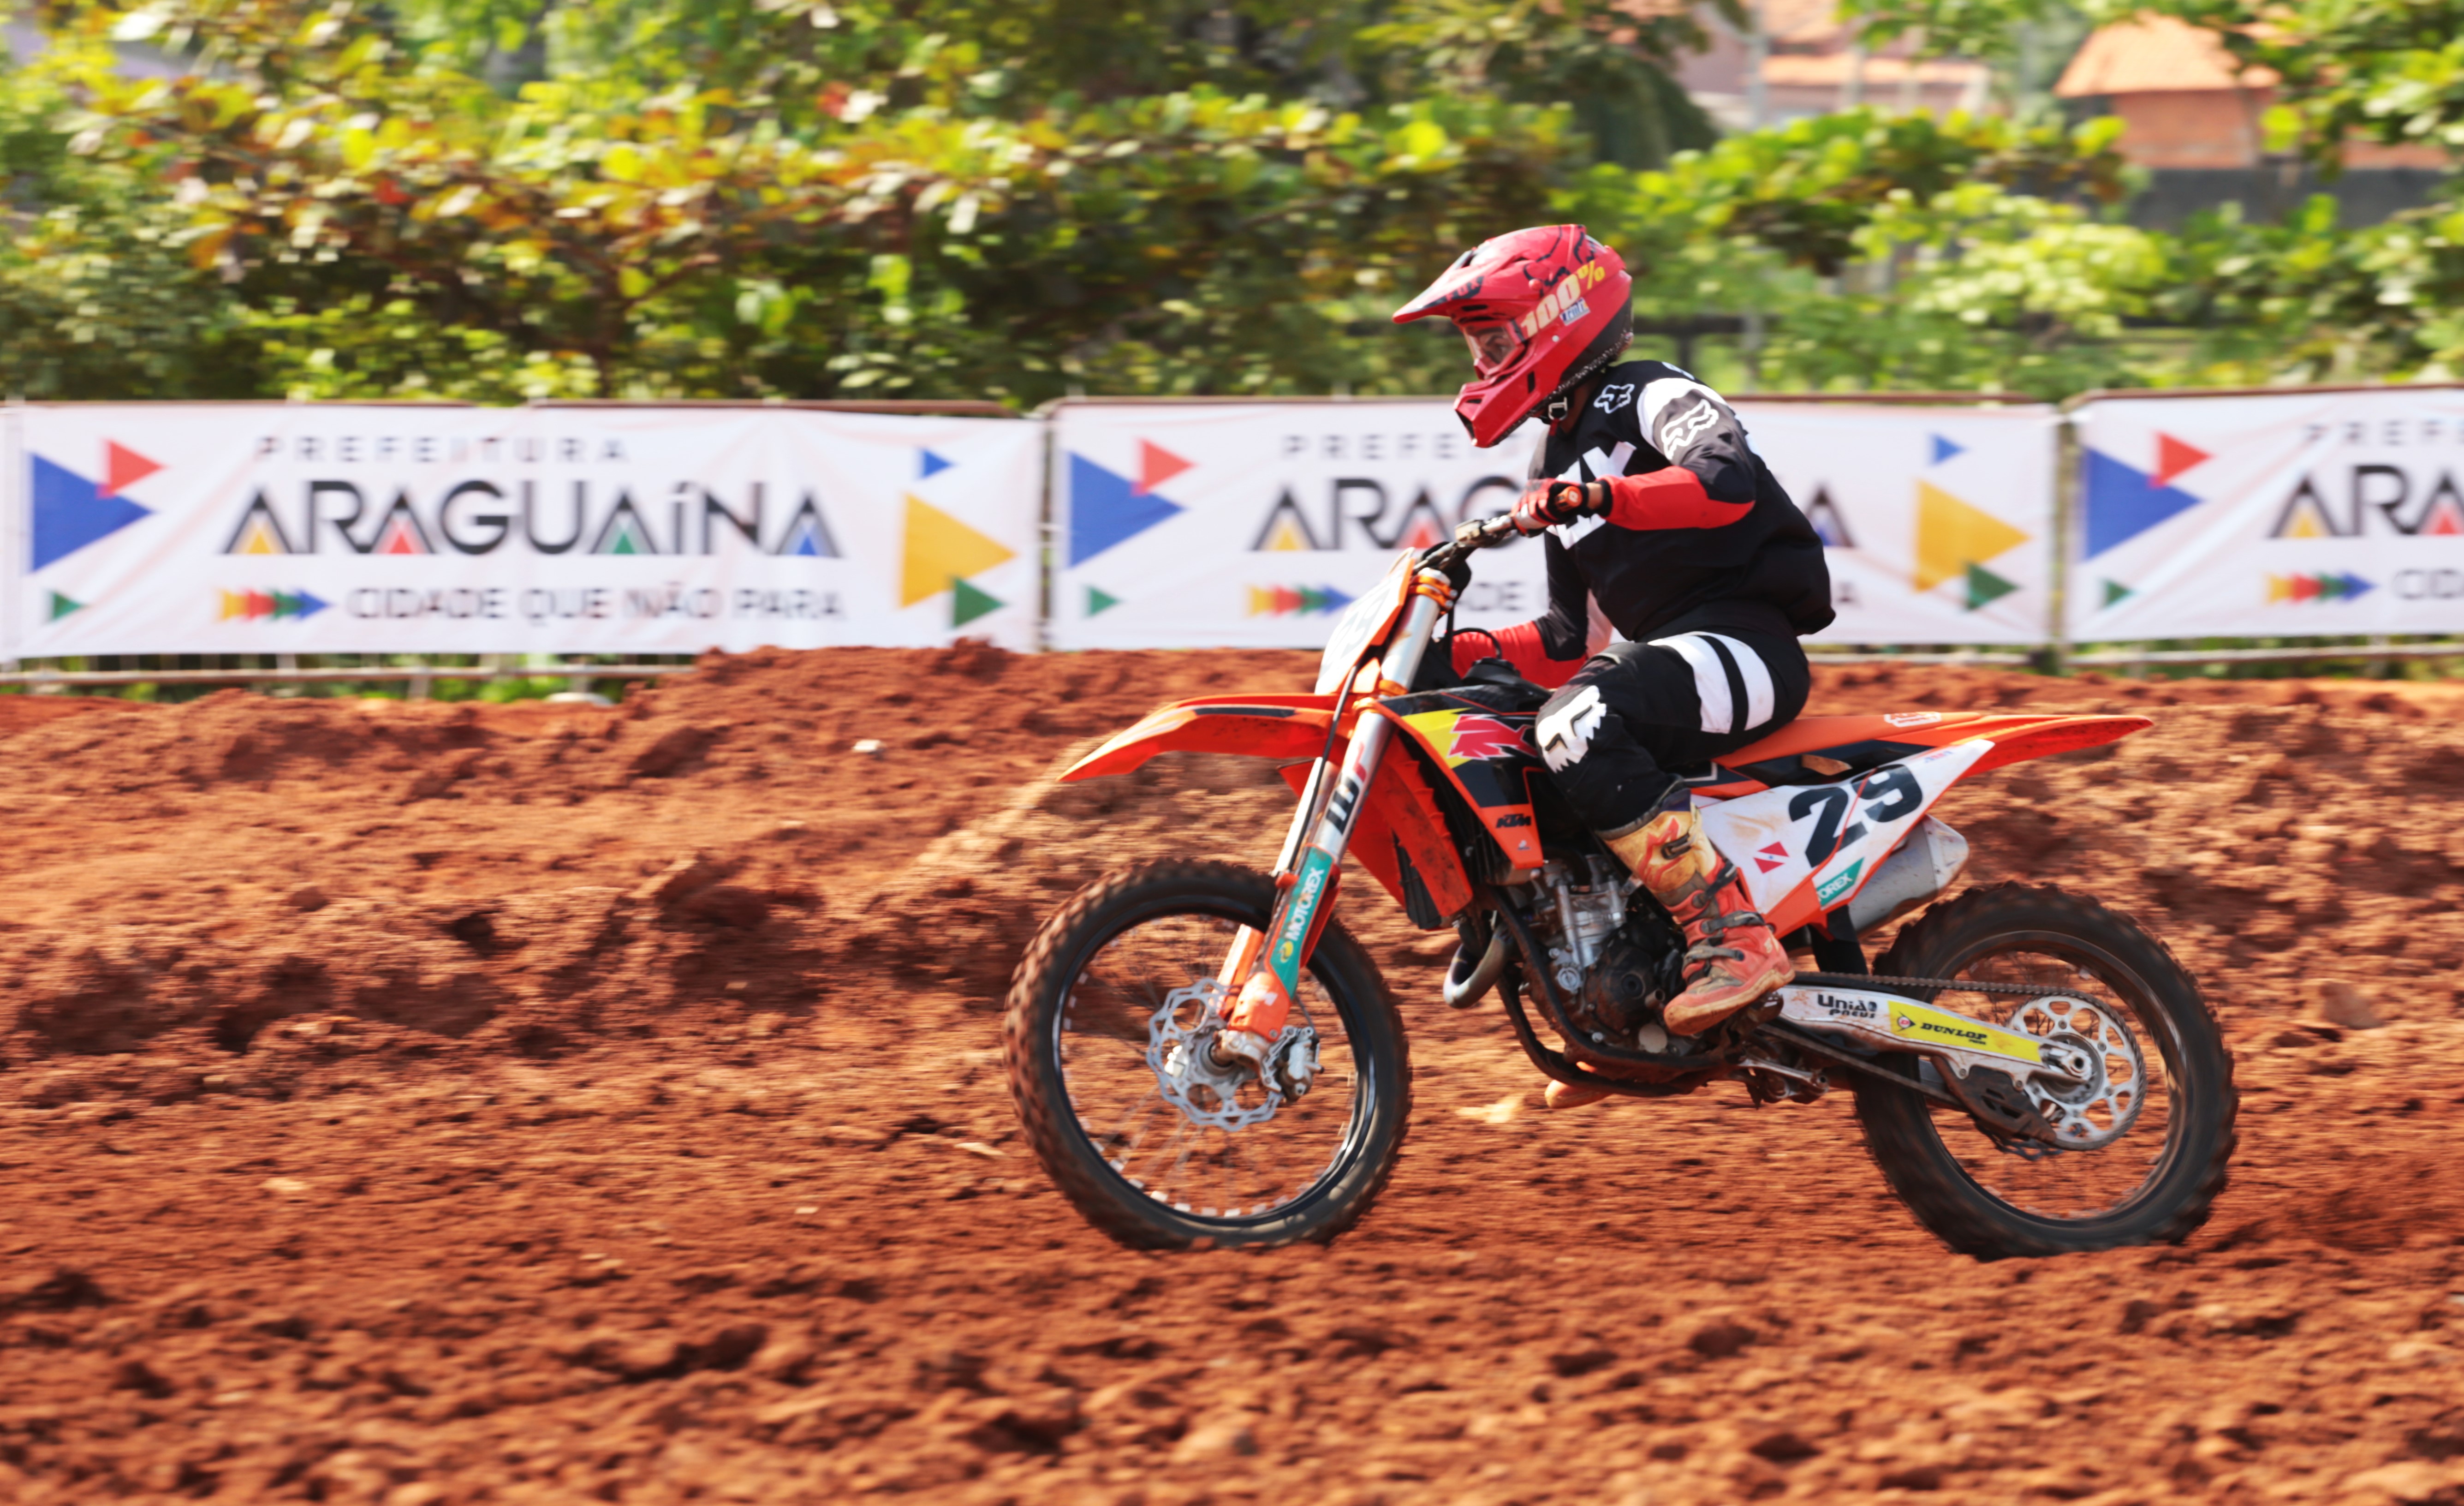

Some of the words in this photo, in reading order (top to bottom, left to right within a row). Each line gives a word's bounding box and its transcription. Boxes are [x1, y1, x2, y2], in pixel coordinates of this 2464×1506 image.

[1520, 260, 1606, 338] 100%
[520, 587, 612, 626] QUE
[1496, 813, 1532, 829] KTM
[1789, 764, 1922, 868] 29
[1285, 867, 1325, 941] MOTOREX
[1816, 872, 1853, 901] OREX
[1920, 1022, 1988, 1040] DUNLOP
